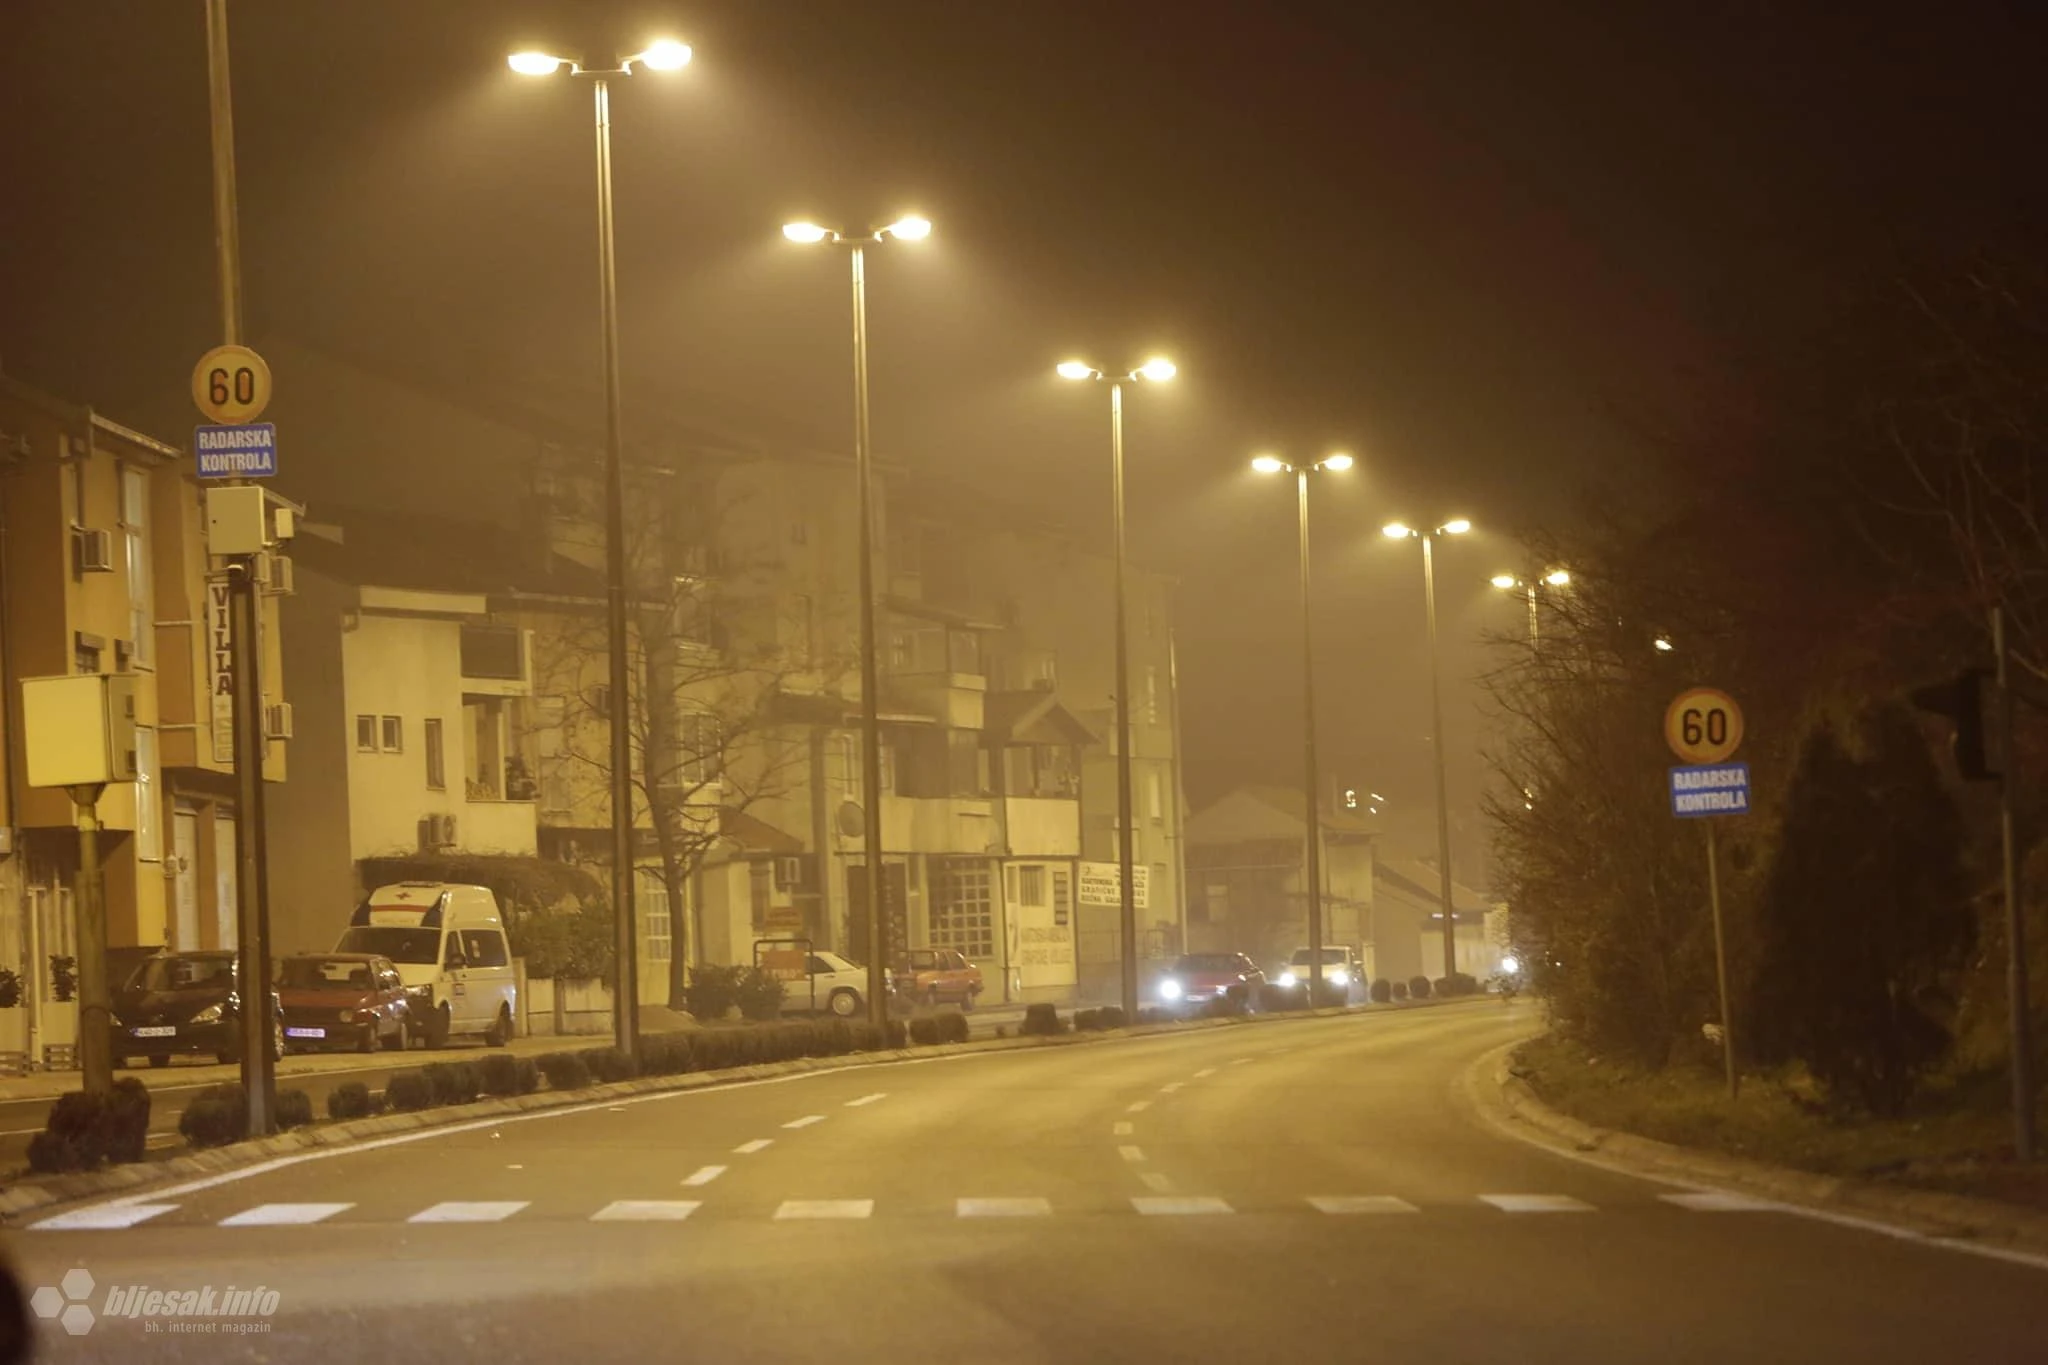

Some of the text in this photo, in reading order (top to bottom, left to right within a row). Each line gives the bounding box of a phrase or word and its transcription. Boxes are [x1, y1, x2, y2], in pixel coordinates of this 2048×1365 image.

[209, 367, 255, 406] 60
[199, 430, 273, 449] RADARSKA
[201, 453, 273, 472] KONTROLA
[211, 585, 233, 696] VILLA
[1682, 708, 1727, 746] 60
[1673, 768, 1746, 790] RADARSKA
[1675, 790, 1747, 812] KONTROLA
